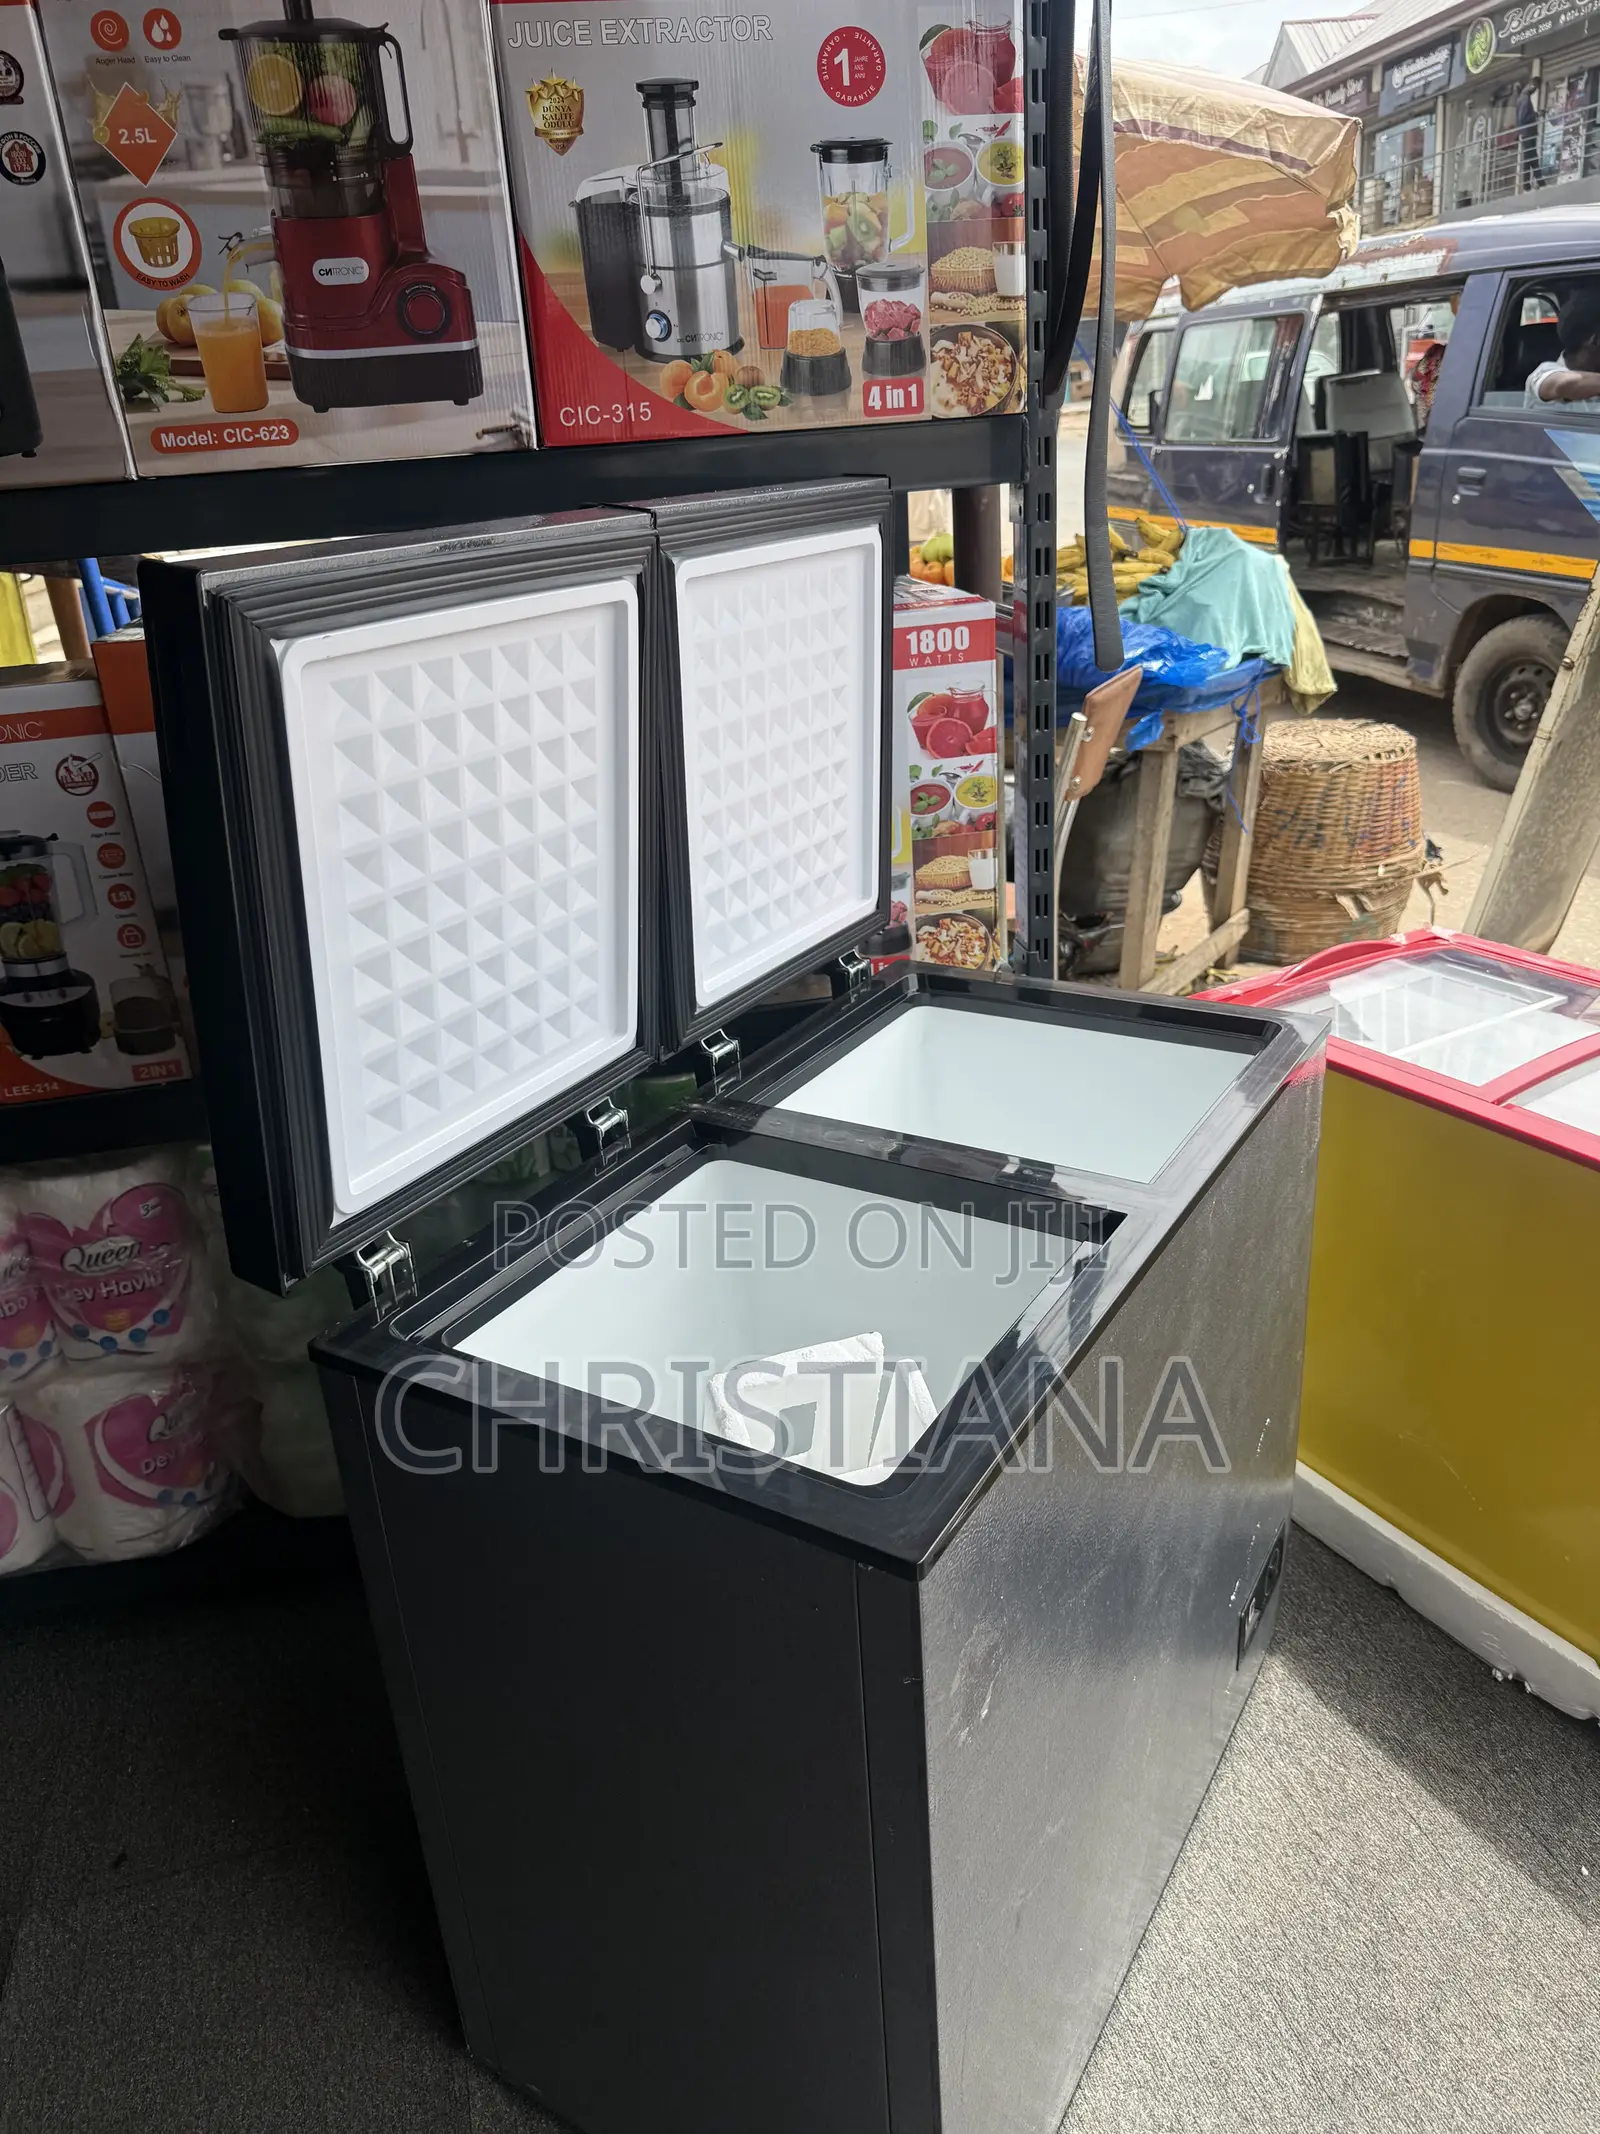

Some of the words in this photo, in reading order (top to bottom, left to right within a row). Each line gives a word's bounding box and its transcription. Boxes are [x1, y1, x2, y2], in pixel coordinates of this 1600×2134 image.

[508, 20, 592, 48] JUICE
[600, 15, 773, 45] EXTRACTOR
[144, 55, 162, 64] Easy
[162, 55, 170, 63] to
[171, 54, 191, 63] Clean
[821, 35, 840, 81] GARANTIE
[833, 48, 850, 86] 1
[853, 55, 868, 63] JAHRE
[835, 85, 876, 102] GARANTIE
[118, 127, 158, 145] 2.5L
[135, 273, 157, 287] EASY
[158, 280, 169, 288] TO
[169, 272, 190, 287] WASH
[868, 385, 882, 410] 4
[886, 384, 905, 409] in
[908, 383, 918, 407] 1
[560, 402, 652, 427] CIC-315
[160, 430, 219, 448] Model:
[223, 425, 290, 444] CIC-623
[906, 626, 970, 655] 1800
[909, 652, 966, 667] WATTS
[4, 1081, 60, 1097] LEE-214
[60, 1240, 142, 1273] Queen
